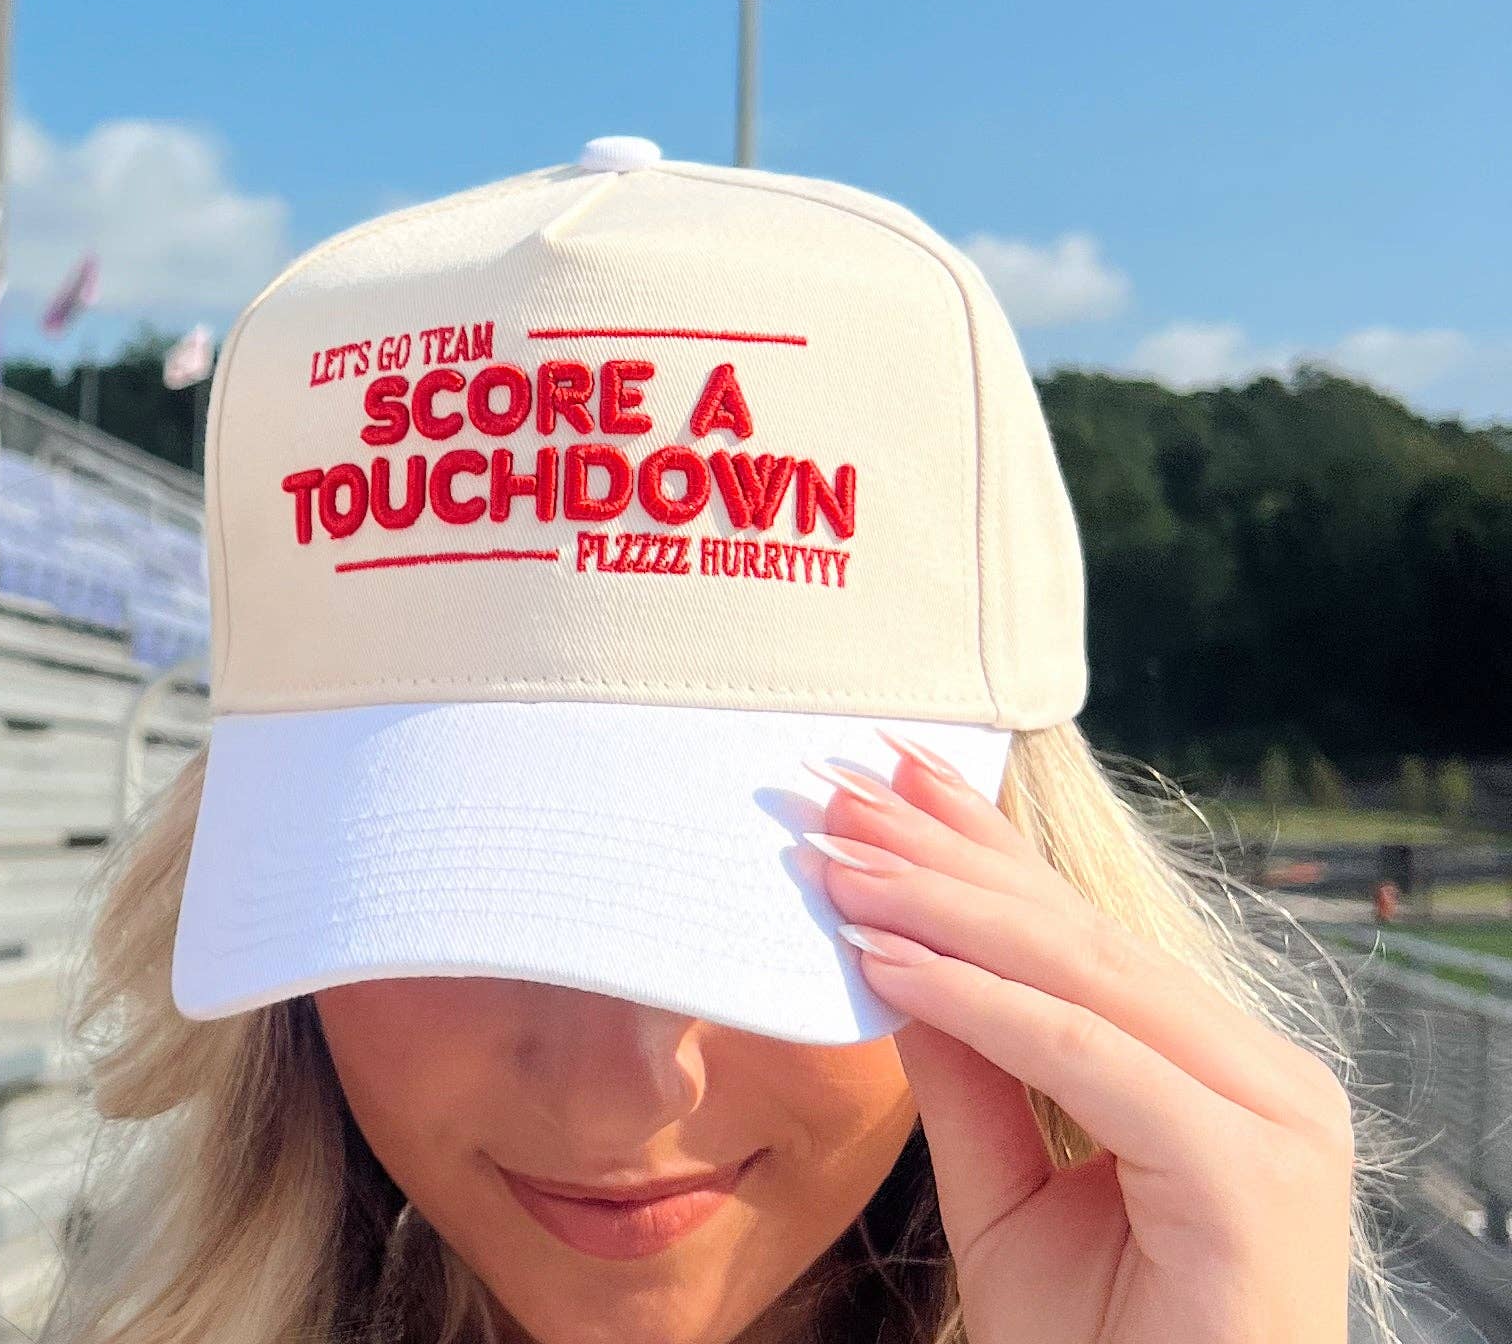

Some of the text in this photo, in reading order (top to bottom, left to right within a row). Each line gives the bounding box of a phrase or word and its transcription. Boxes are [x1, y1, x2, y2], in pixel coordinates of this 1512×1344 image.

[309, 320, 495, 388] LET'S GO TEAM
[359, 359, 755, 447] SCORE A
[281, 443, 857, 546] TOUCHDOWN
[700, 536, 851, 588] HURRYYYY
